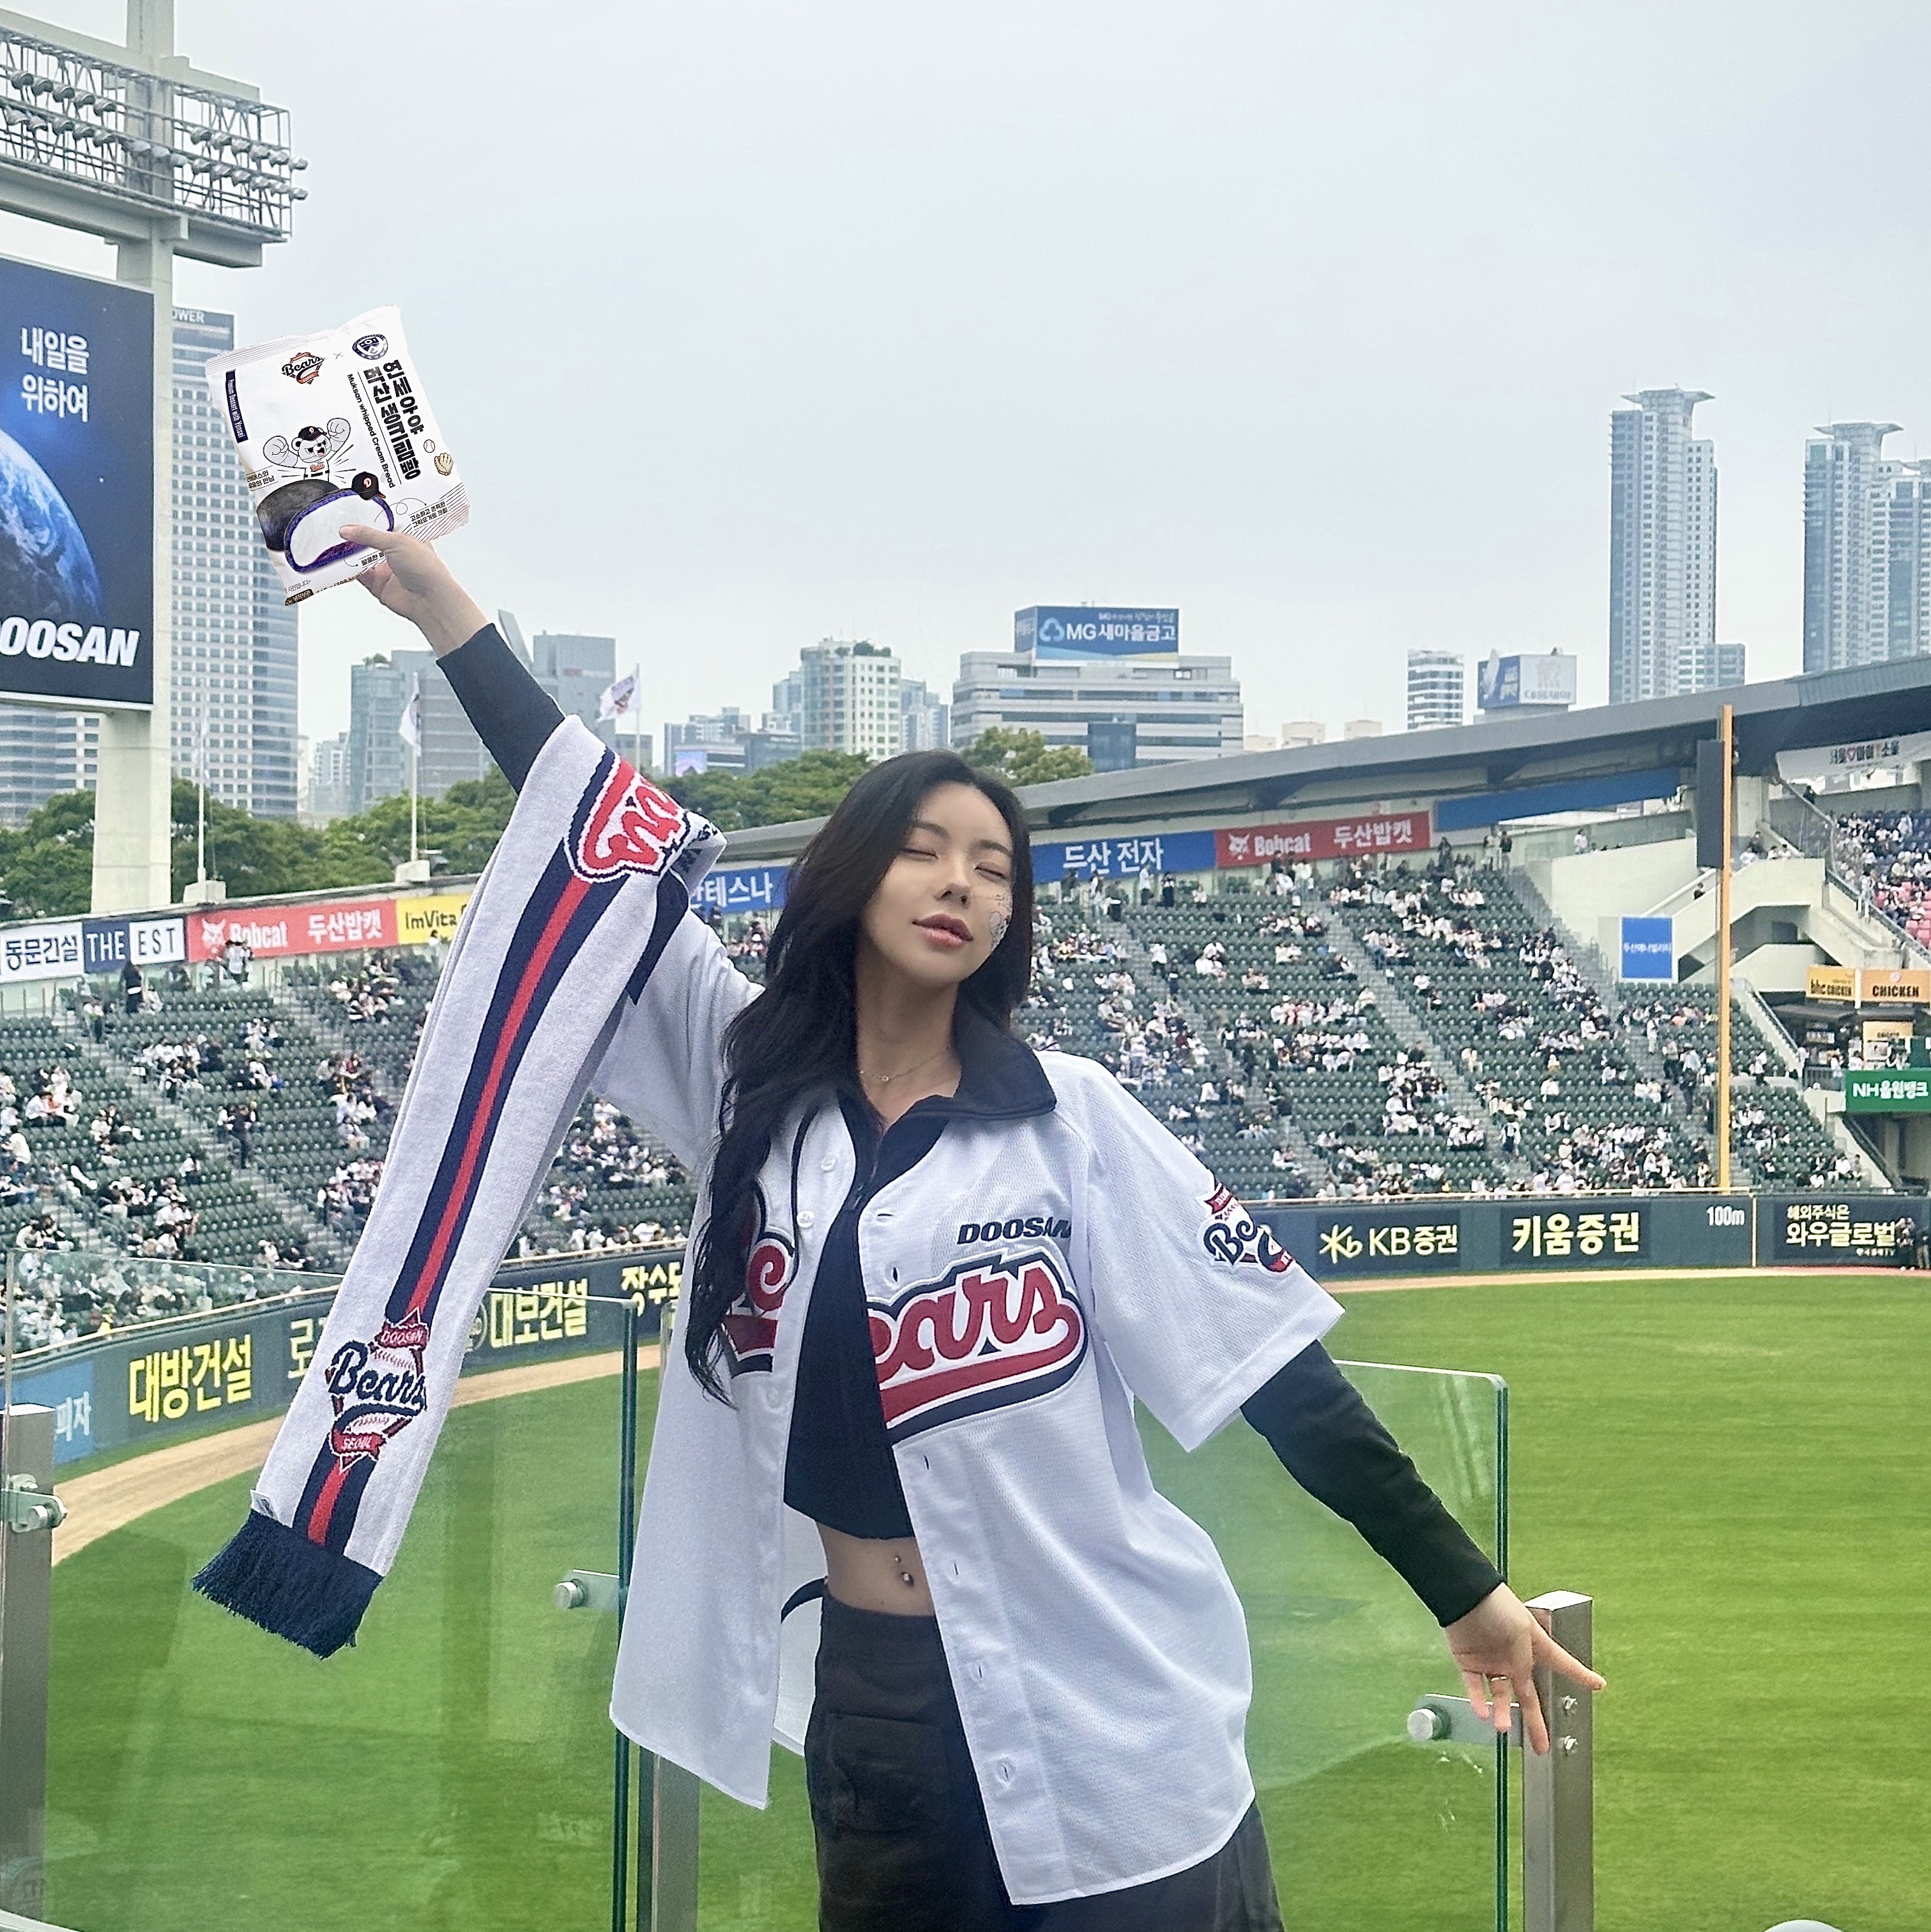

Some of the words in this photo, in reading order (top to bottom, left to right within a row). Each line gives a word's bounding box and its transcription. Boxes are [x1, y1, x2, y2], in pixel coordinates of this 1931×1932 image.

[172, 308, 204, 323] OWER
[22, 326, 89, 375] 내일을
[282, 356, 325, 379] Bears
[21, 374, 88, 423] 위하여
[383, 360, 424, 435] 연세우유
[234, 420, 245, 438] Yonsei
[347, 374, 362, 404] Muksan
[359, 403, 376, 437] whipped
[372, 436, 385, 464] Cream
[382, 462, 395, 488] Bread
[381, 402, 421, 480] 생크림빵
[263, 475, 275, 484] 만남
[410, 508, 431, 522] 고소하고
[0, 616, 140, 667] OOSAN
[1117, 837, 1164, 873] 전자
[1254, 833, 1311, 856] Bobcat
[1334, 819, 1412, 849] 두산밥캣
[307, 908, 382, 945] 두산밥캣
[6, 934, 78, 970] 동문건설
[87, 931, 126, 962] THE
[137, 928, 176, 955] EST
[1872, 985, 1920, 998] CHICKEN
[1853, 1080, 1929, 1099] NH올원뱅크
[1707, 1205, 1745, 1226] 100m
[1787, 1204, 1851, 1221] 해외주식은
[1369, 1224, 1458, 1256] KB증권
[1512, 1212, 1640, 1257] 키움증권
[1785, 1221, 1896, 1247] 와우글로벌
[490, 1278, 587, 1348] 대보건설
[381, 1329, 424, 1343] DOOSAN
[129, 1334, 252, 1422] 대방건설
[328, 1340, 427, 1408] Bears
[56, 1391, 91, 1441] 피자
[342, 1436, 372, 1450] SEOUL
